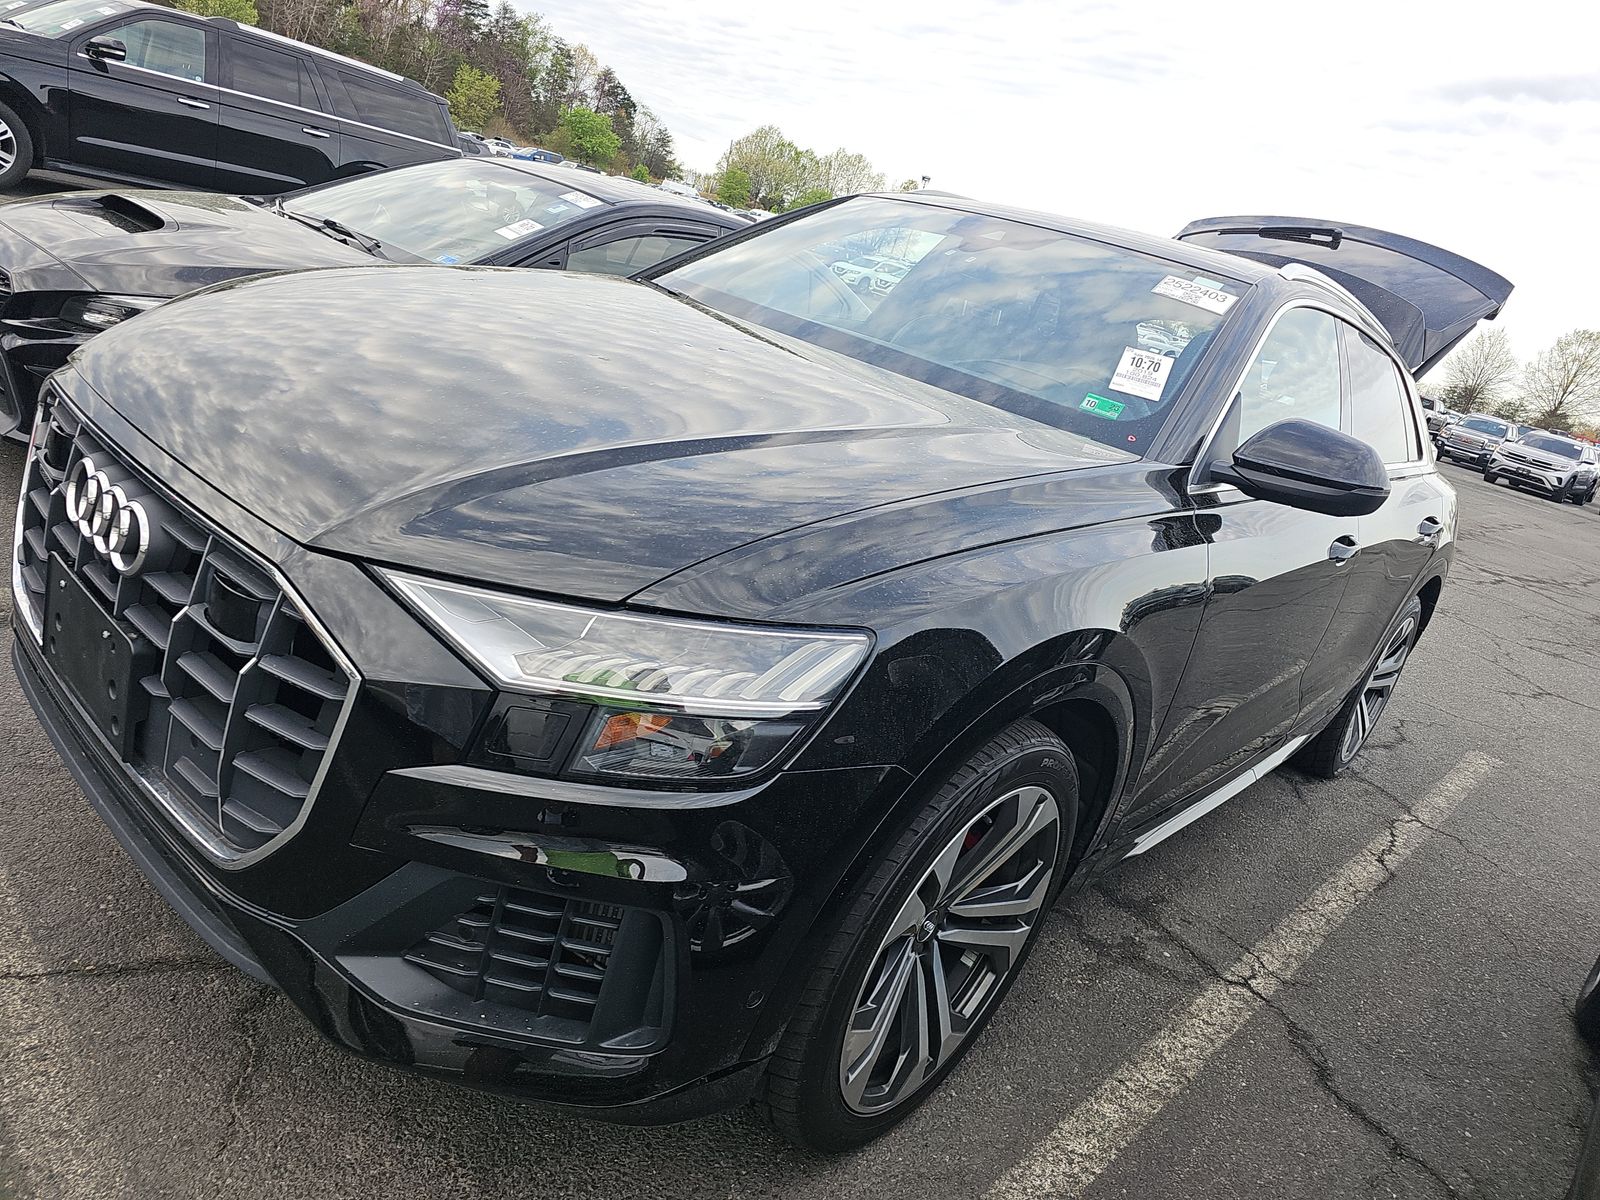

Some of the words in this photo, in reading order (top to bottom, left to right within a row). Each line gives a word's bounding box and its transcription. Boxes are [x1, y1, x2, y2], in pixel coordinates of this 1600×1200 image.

[1163, 278, 1228, 303] 2522403
[1130, 356, 1161, 373] 10:70
[1085, 399, 1096, 408] 10
